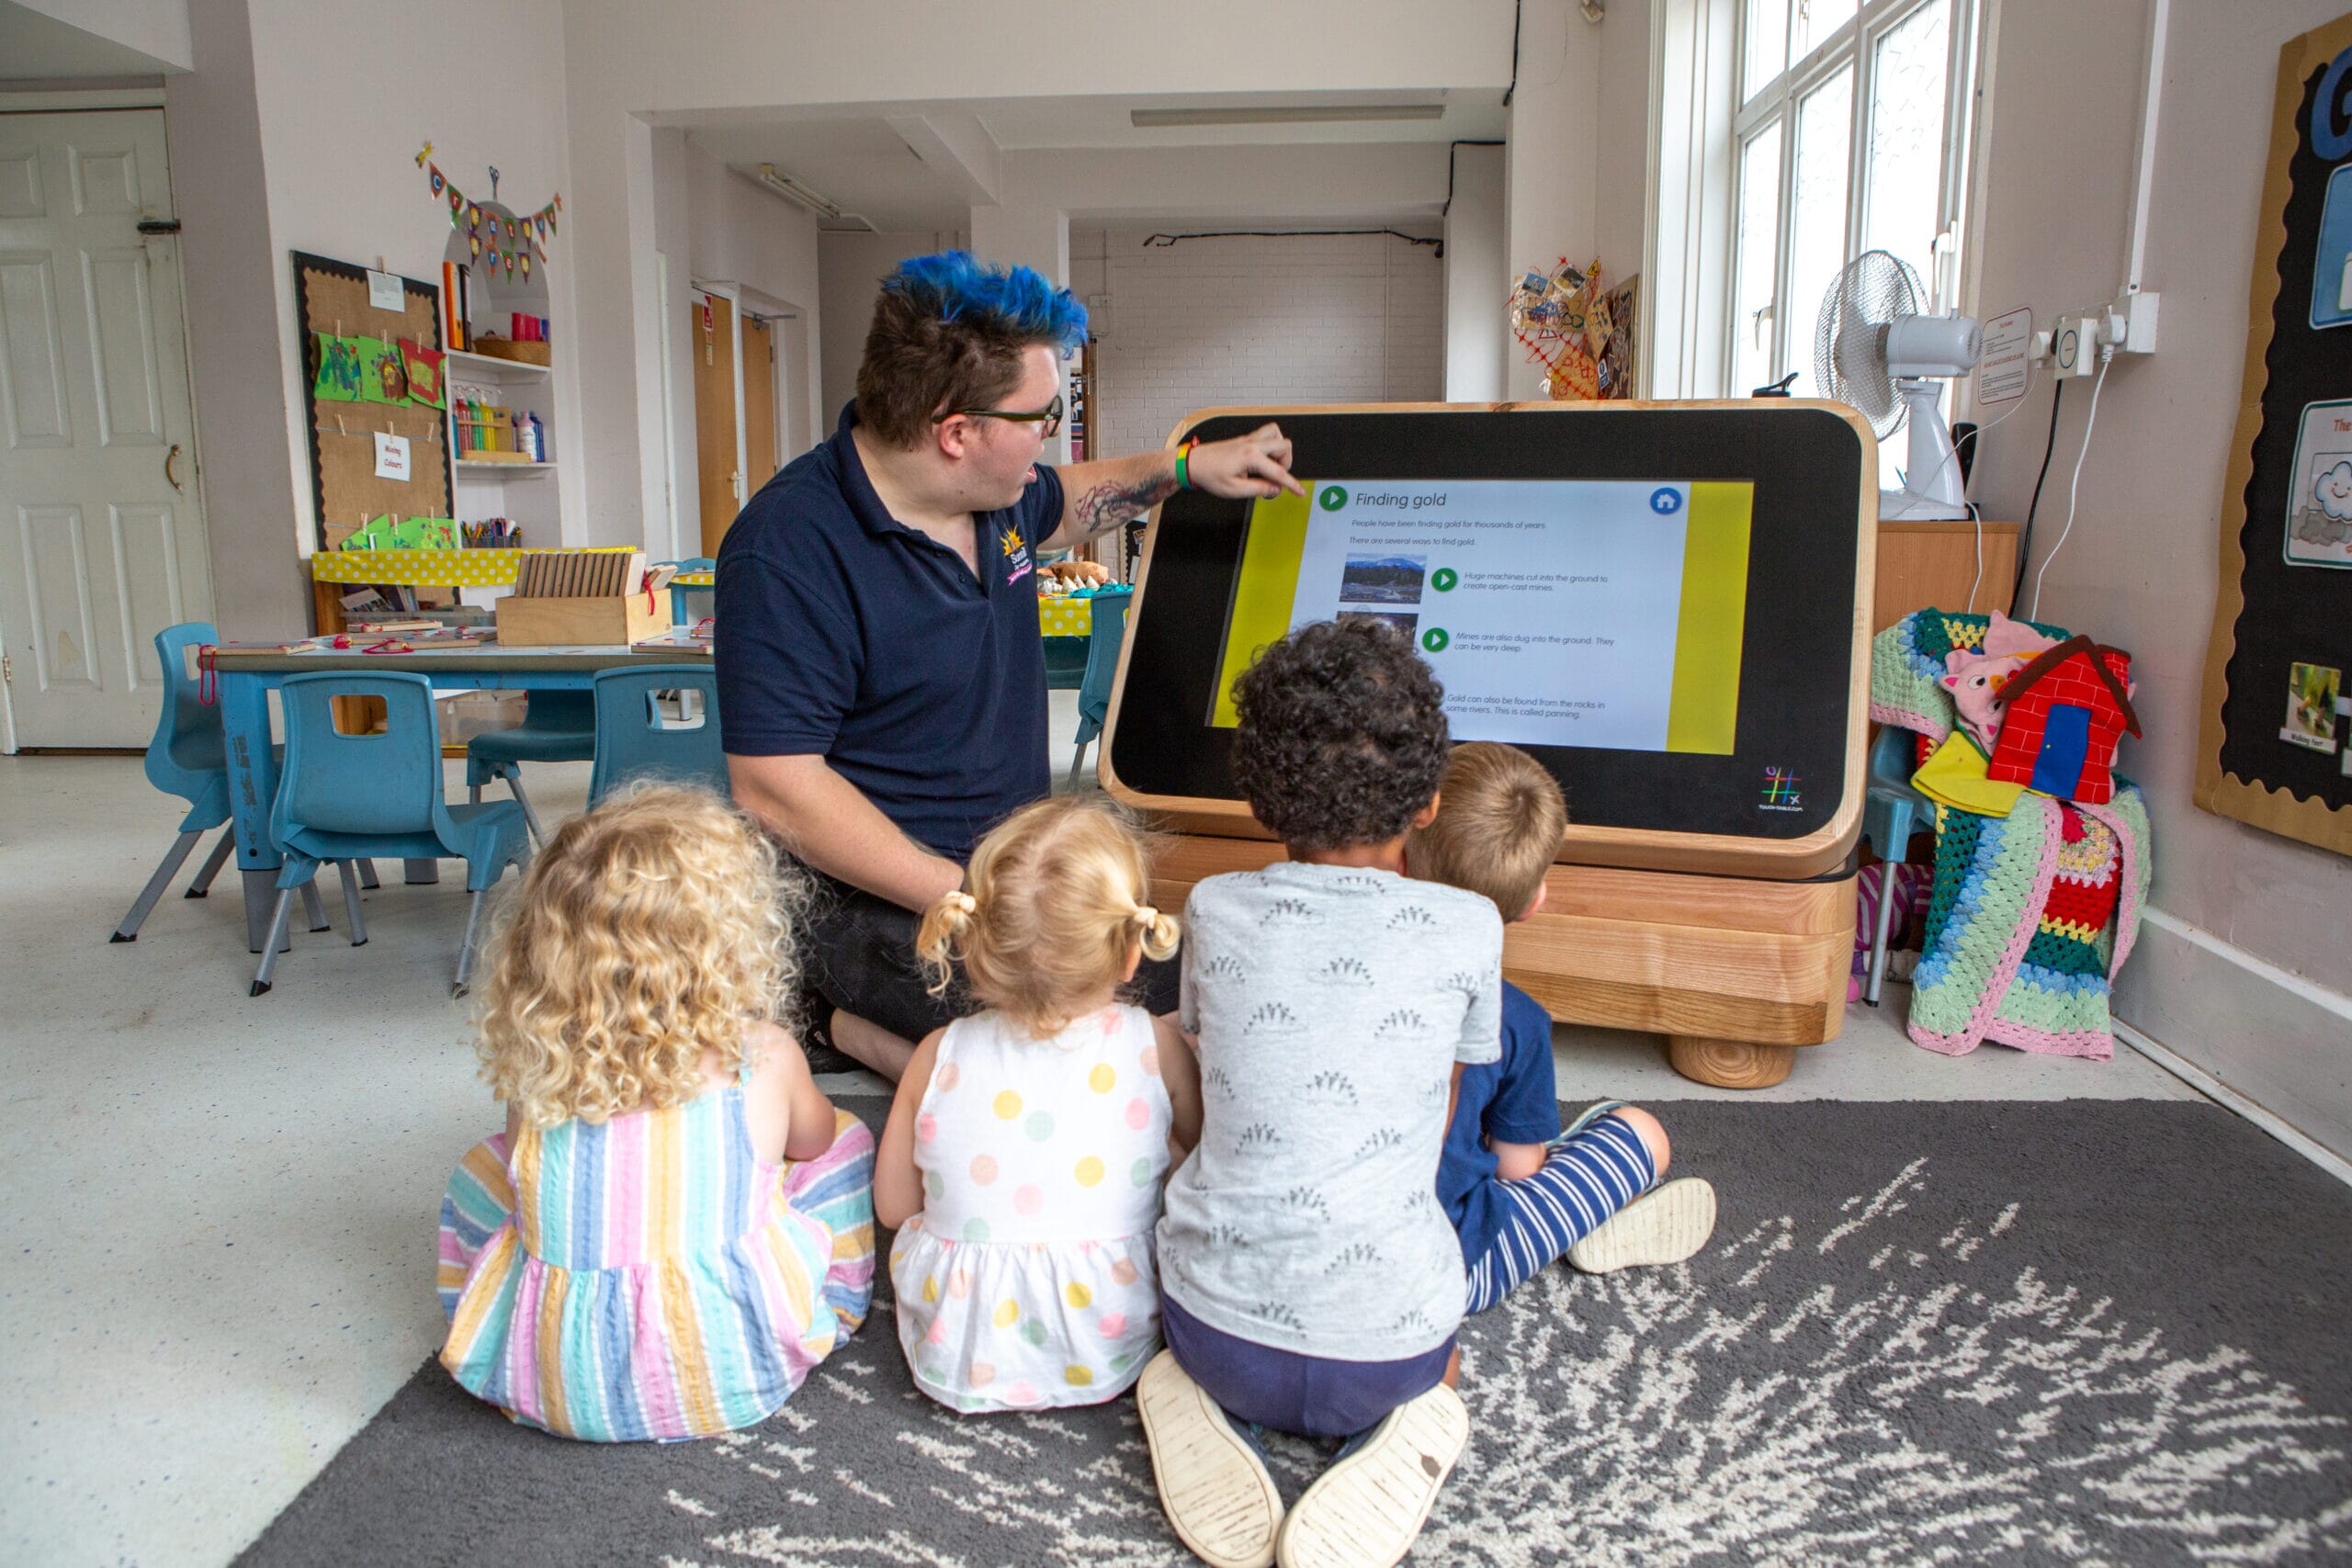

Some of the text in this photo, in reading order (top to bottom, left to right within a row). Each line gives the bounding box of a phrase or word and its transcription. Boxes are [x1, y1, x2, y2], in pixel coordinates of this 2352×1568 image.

[1356, 493, 1447, 509] Finding gold
[1351, 519, 1377, 528] People
[1378, 520, 1396, 528] have
[1397, 520, 1417, 528] been
[1417, 520, 1443, 529] finding
[1444, 520, 1462, 530] gold
[1462, 521, 1473, 529] for
[1474, 521, 1514, 530] thousands
[1515, 521, 1524, 529] of
[1349, 536, 1370, 545] There
[1412, 538, 1432, 547] ways
[1442, 537, 1457, 546] find
[1464, 572, 1486, 581] Huge
[1487, 573, 1525, 581] machines
[1526, 574, 1539, 582] cut
[1539, 574, 1555, 582] into
[1568, 575, 1599, 584] ground
[1488, 583, 1528, 592] open-cast
[1456, 632, 1480, 641] Mines
[1496, 634, 1513, 642] also
[1514, 635, 1531, 644] dug
[1532, 635, 1547, 643] into
[1595, 637, 1615, 647] They
[1454, 643, 1469, 651] can
[1470, 643, 1482, 651] be
[1482, 645, 1499, 653] very
[1447, 694, 1606, 709] Gold can also be found from the rocks in
[1445, 705, 1468, 713] some
[1494, 706, 1510, 716] This
[1510, 707, 1519, 716] is
[1520, 708, 1544, 716] called
